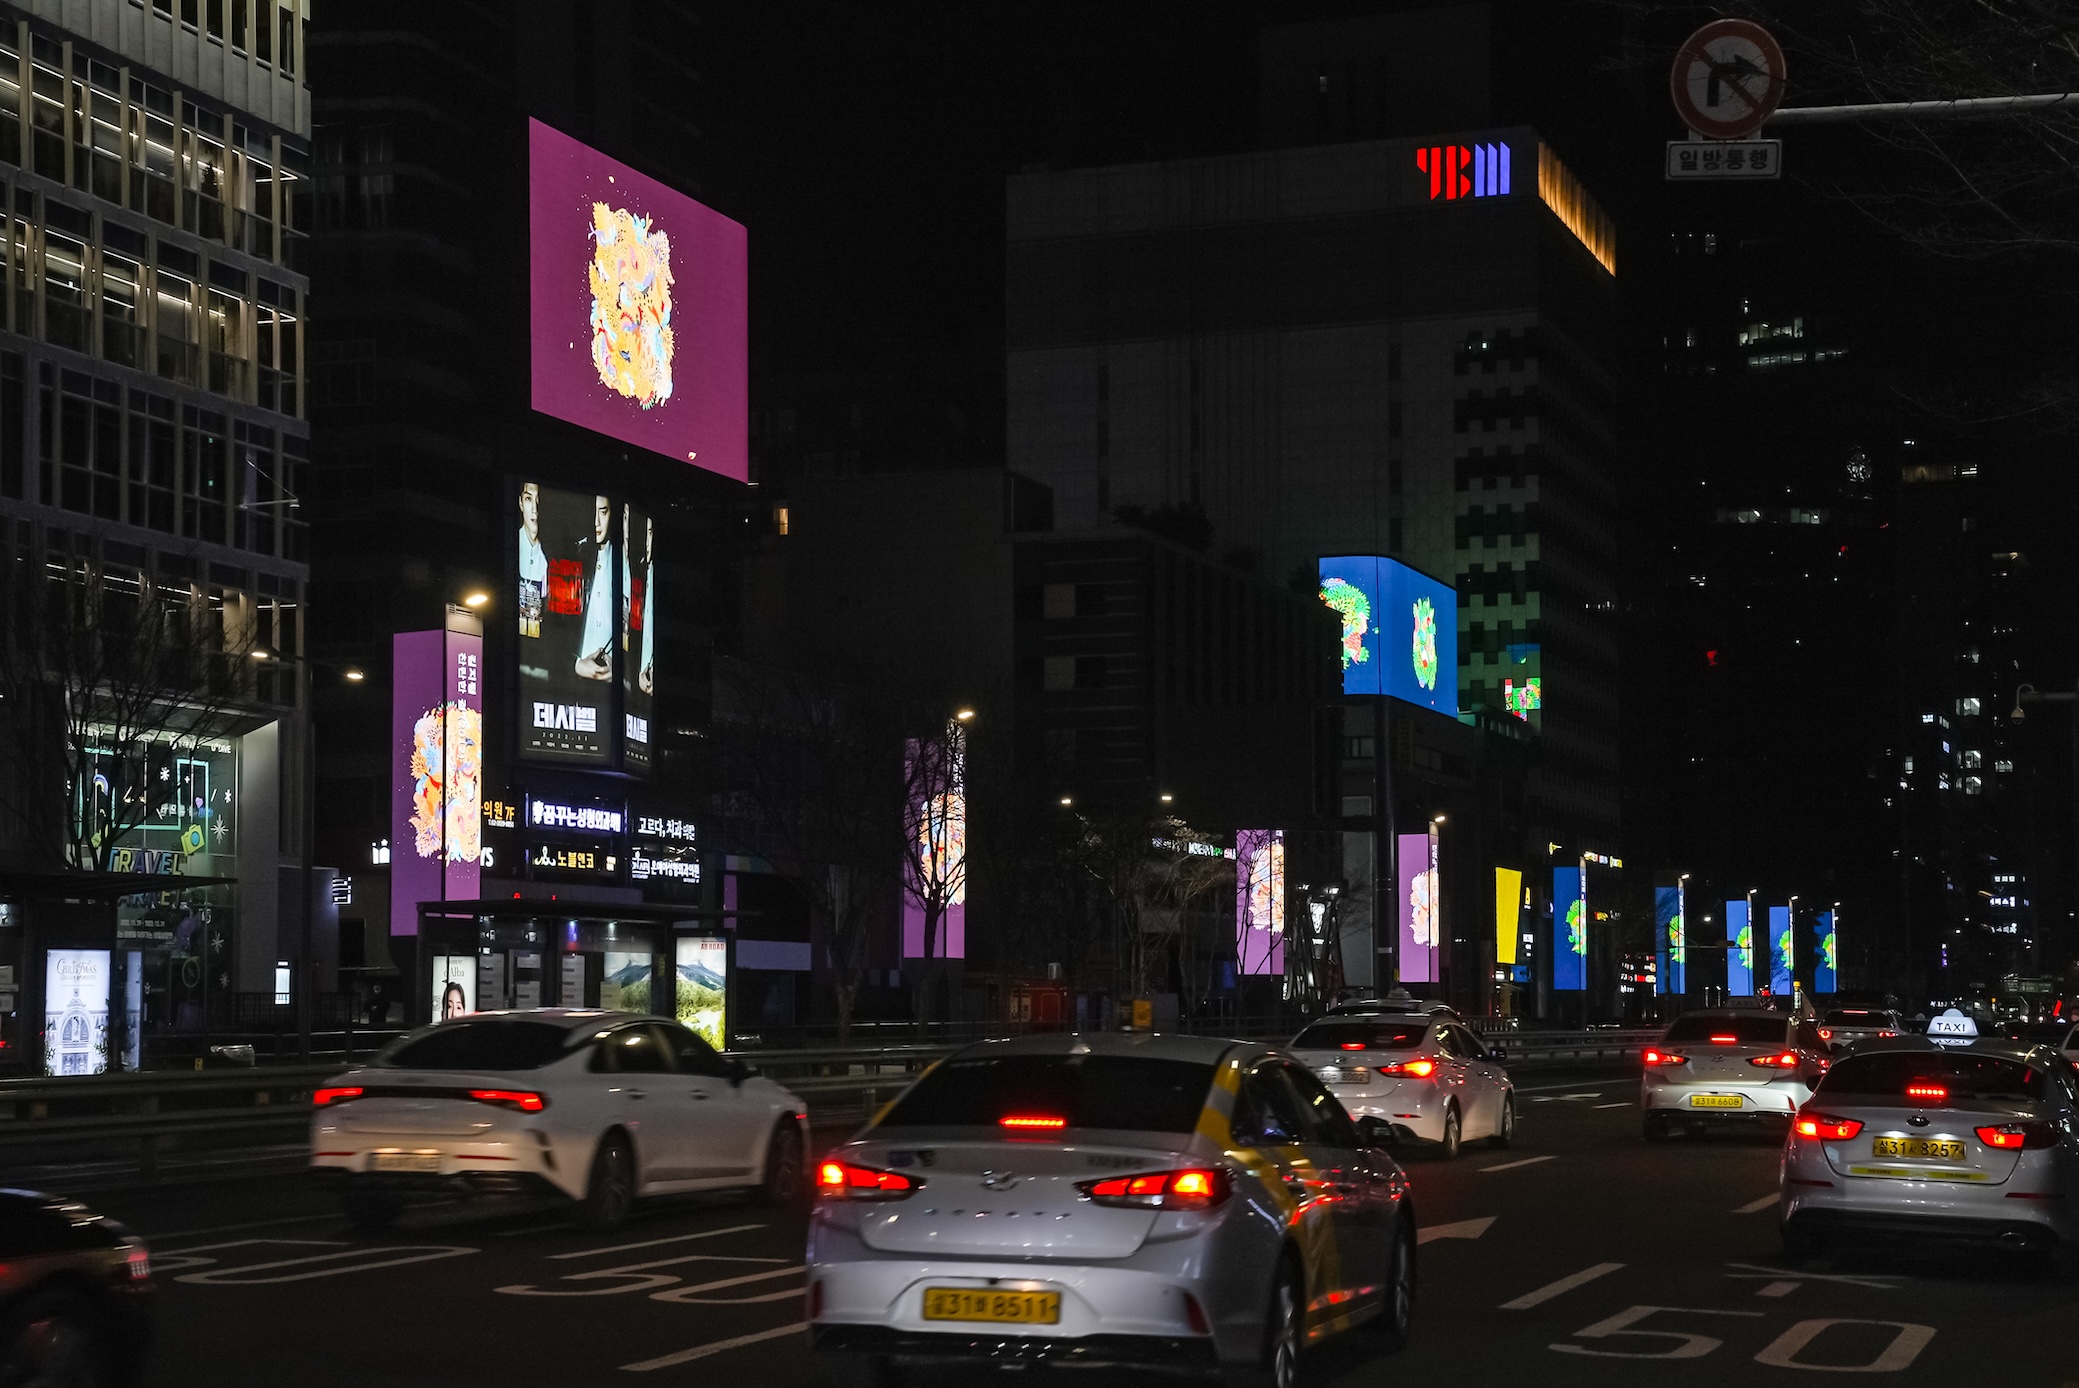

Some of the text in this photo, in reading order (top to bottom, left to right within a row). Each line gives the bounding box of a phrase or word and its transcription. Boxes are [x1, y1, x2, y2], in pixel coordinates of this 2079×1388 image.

[1679, 148, 1768, 171] 일방통행
[458, 652, 467, 694] 찬란한
[533, 702, 597, 732] 데시벨
[481, 800, 503, 820] 의원
[107, 849, 184, 876] TRAVEL
[1936, 1022, 1966, 1032] TAXI
[1920, 1142, 1960, 1158] 8257
[1547, 1304, 1938, 1373] 50
